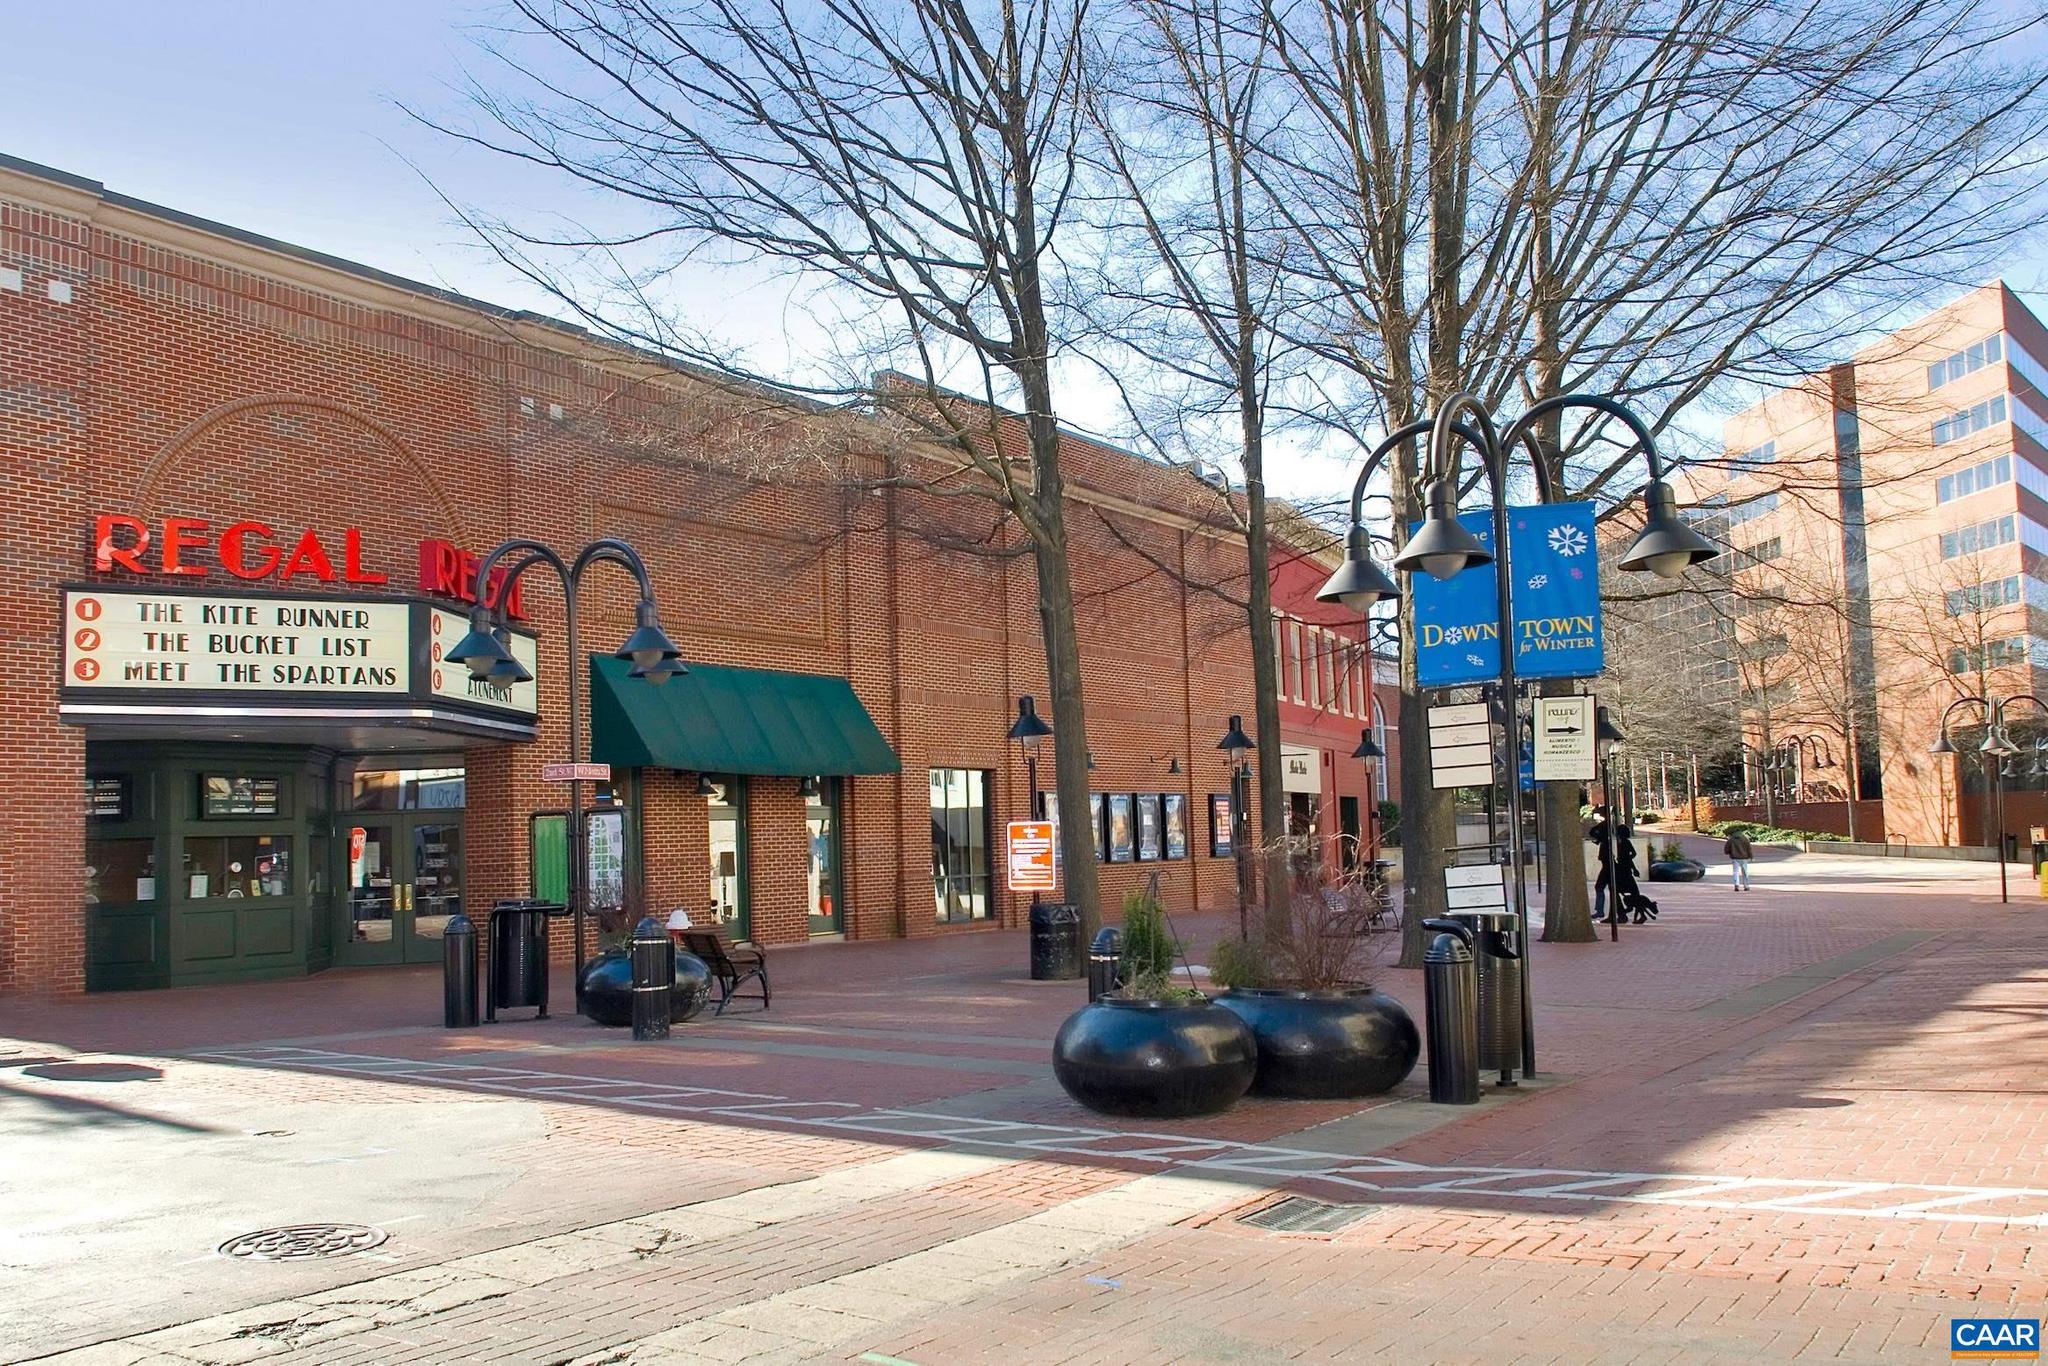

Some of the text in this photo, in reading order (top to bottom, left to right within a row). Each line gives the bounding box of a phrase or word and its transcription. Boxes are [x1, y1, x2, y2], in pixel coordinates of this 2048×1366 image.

[96, 514, 388, 584] REGAL
[420, 539, 530, 621] REGL
[137, 602, 183, 623] THE
[203, 604, 259, 626] KITE
[277, 607, 370, 630] RUNNER
[1519, 615, 1595, 638] TOWN
[143, 632, 189, 652] THE
[209, 634, 299, 656] BUCKET
[322, 637, 371, 657] LIST
[1519, 638, 1595, 656] for WINTER
[123, 661, 190, 682] MEET
[217, 663, 262, 683] THE
[273, 664, 397, 687] SPARTANS
